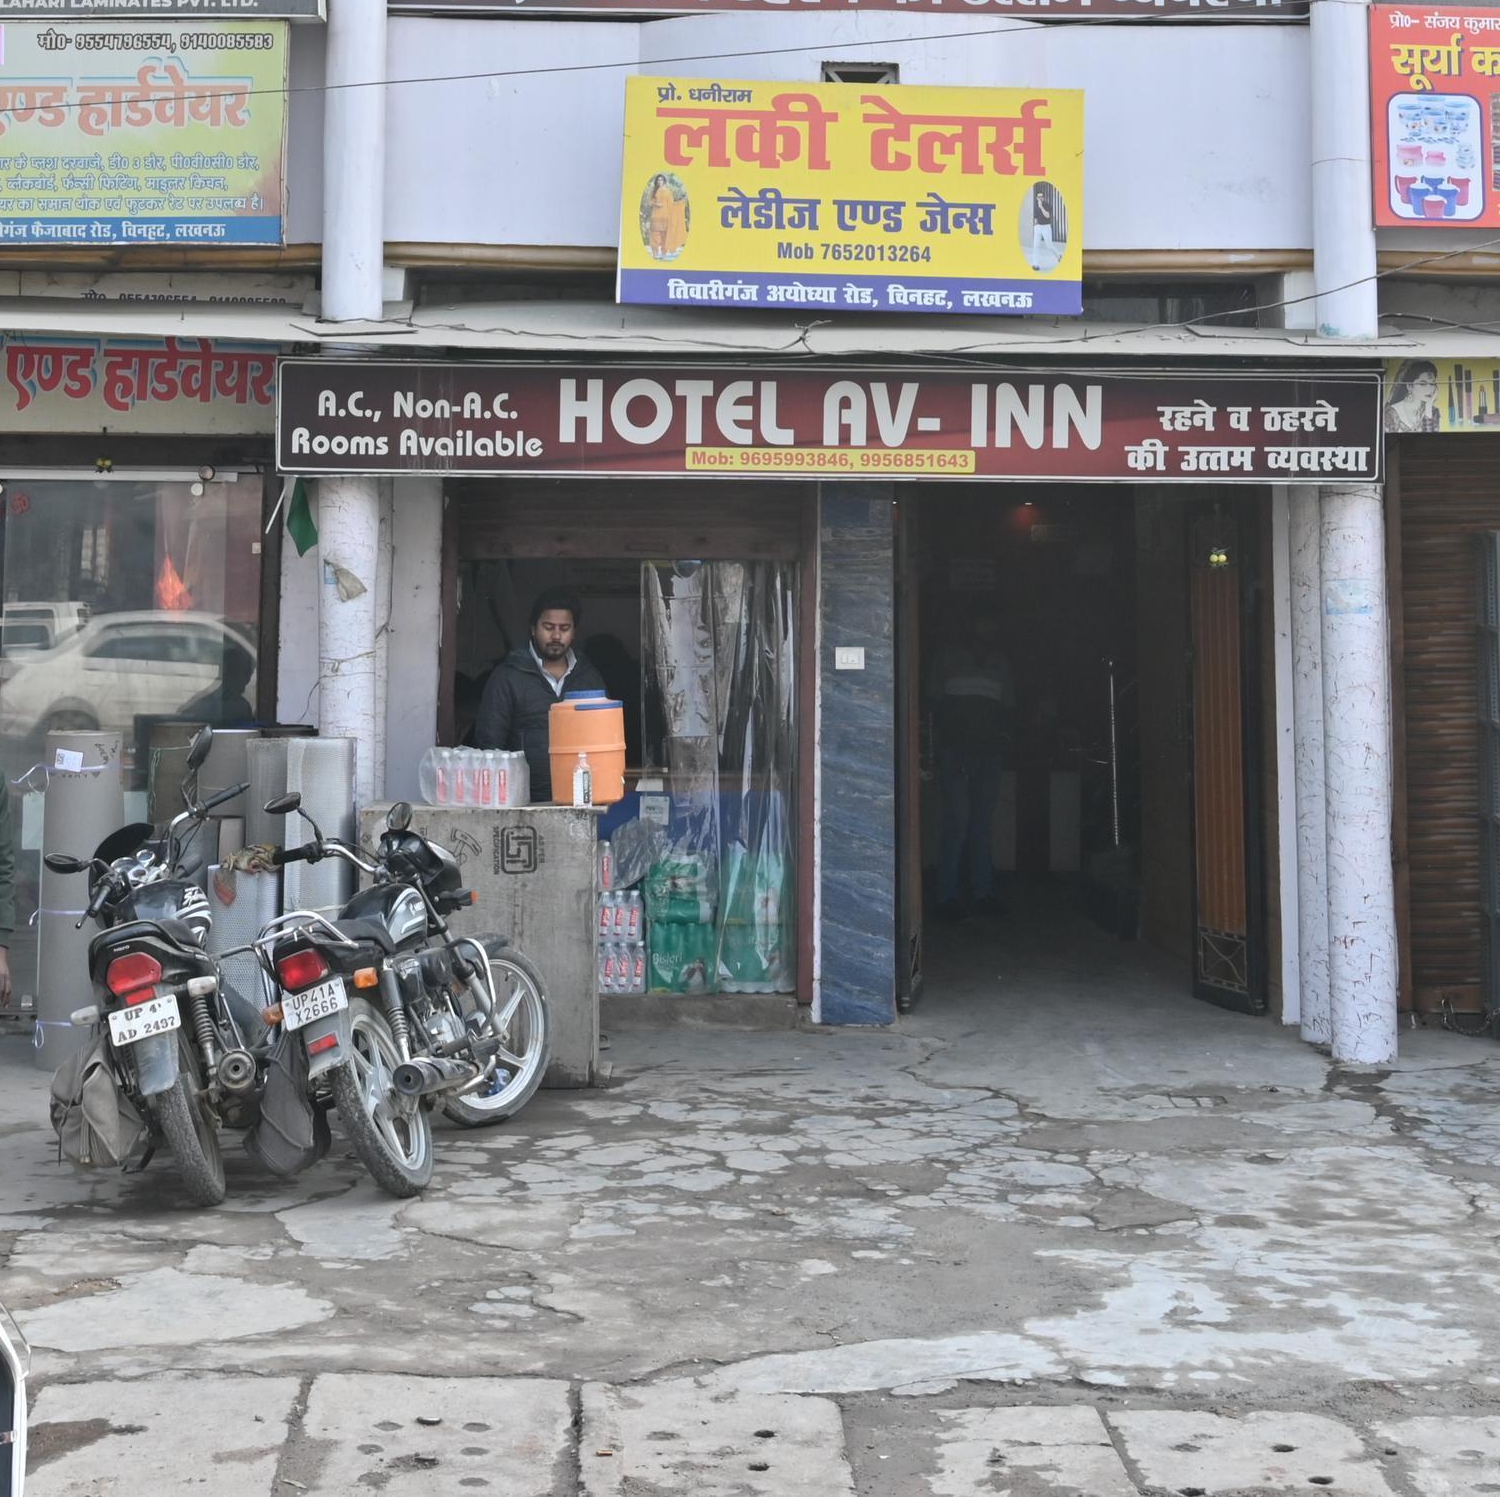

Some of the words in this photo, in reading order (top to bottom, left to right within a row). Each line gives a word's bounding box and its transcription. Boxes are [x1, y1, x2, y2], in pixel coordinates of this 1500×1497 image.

[1424, 11, 1461, 30] संजय
[180, 33, 273, 51] 9140085583
[1389, 33, 1464, 91] सूर्या
[76, 65, 249, 136] हार्डवेयर
[688, 84, 752, 104] धनीराम
[656, 93, 839, 171] लकी
[860, 94, 1051, 177] टेलर्स
[717, 186, 821, 230] लेडीज
[832, 199, 906, 232] एण्ड
[915, 192, 996, 236] जेन्स
[777, 241, 815, 260] Mob
[820, 243, 931, 263] 7652013264
[668, 278, 759, 302] तिवारीगंज
[6, 345, 100, 412] एण्ड
[102, 334, 275, 413] हार्डवेयर
[393, 391, 518, 419] Non-A.C.
[559, 378, 795, 445] HOTEL
[823, 380, 940, 448] AV-
[970, 383, 1102, 450] INN
[1157, 399, 1217, 431] रहने
[1227, 406, 1252, 431] व
[1260, 400, 1339, 431] ठहरने
[291, 427, 389, 455] Rooms
[399, 429, 543, 457] Available
[1124, 439, 1169, 471] की
[1178, 446, 1255, 471] उत्तम
[1264, 446, 1370, 472] व्यवस्था
[692, 449, 734, 466] Mob:
[739, 451, 855, 470] 9695993846,
[860, 452, 969, 469] 9956851643
[291, 983, 336, 1011] UP41A
[294, 996, 339, 1025] X2666
[123, 1007, 143, 1022] UP
[117, 1028, 138, 1043] AD
